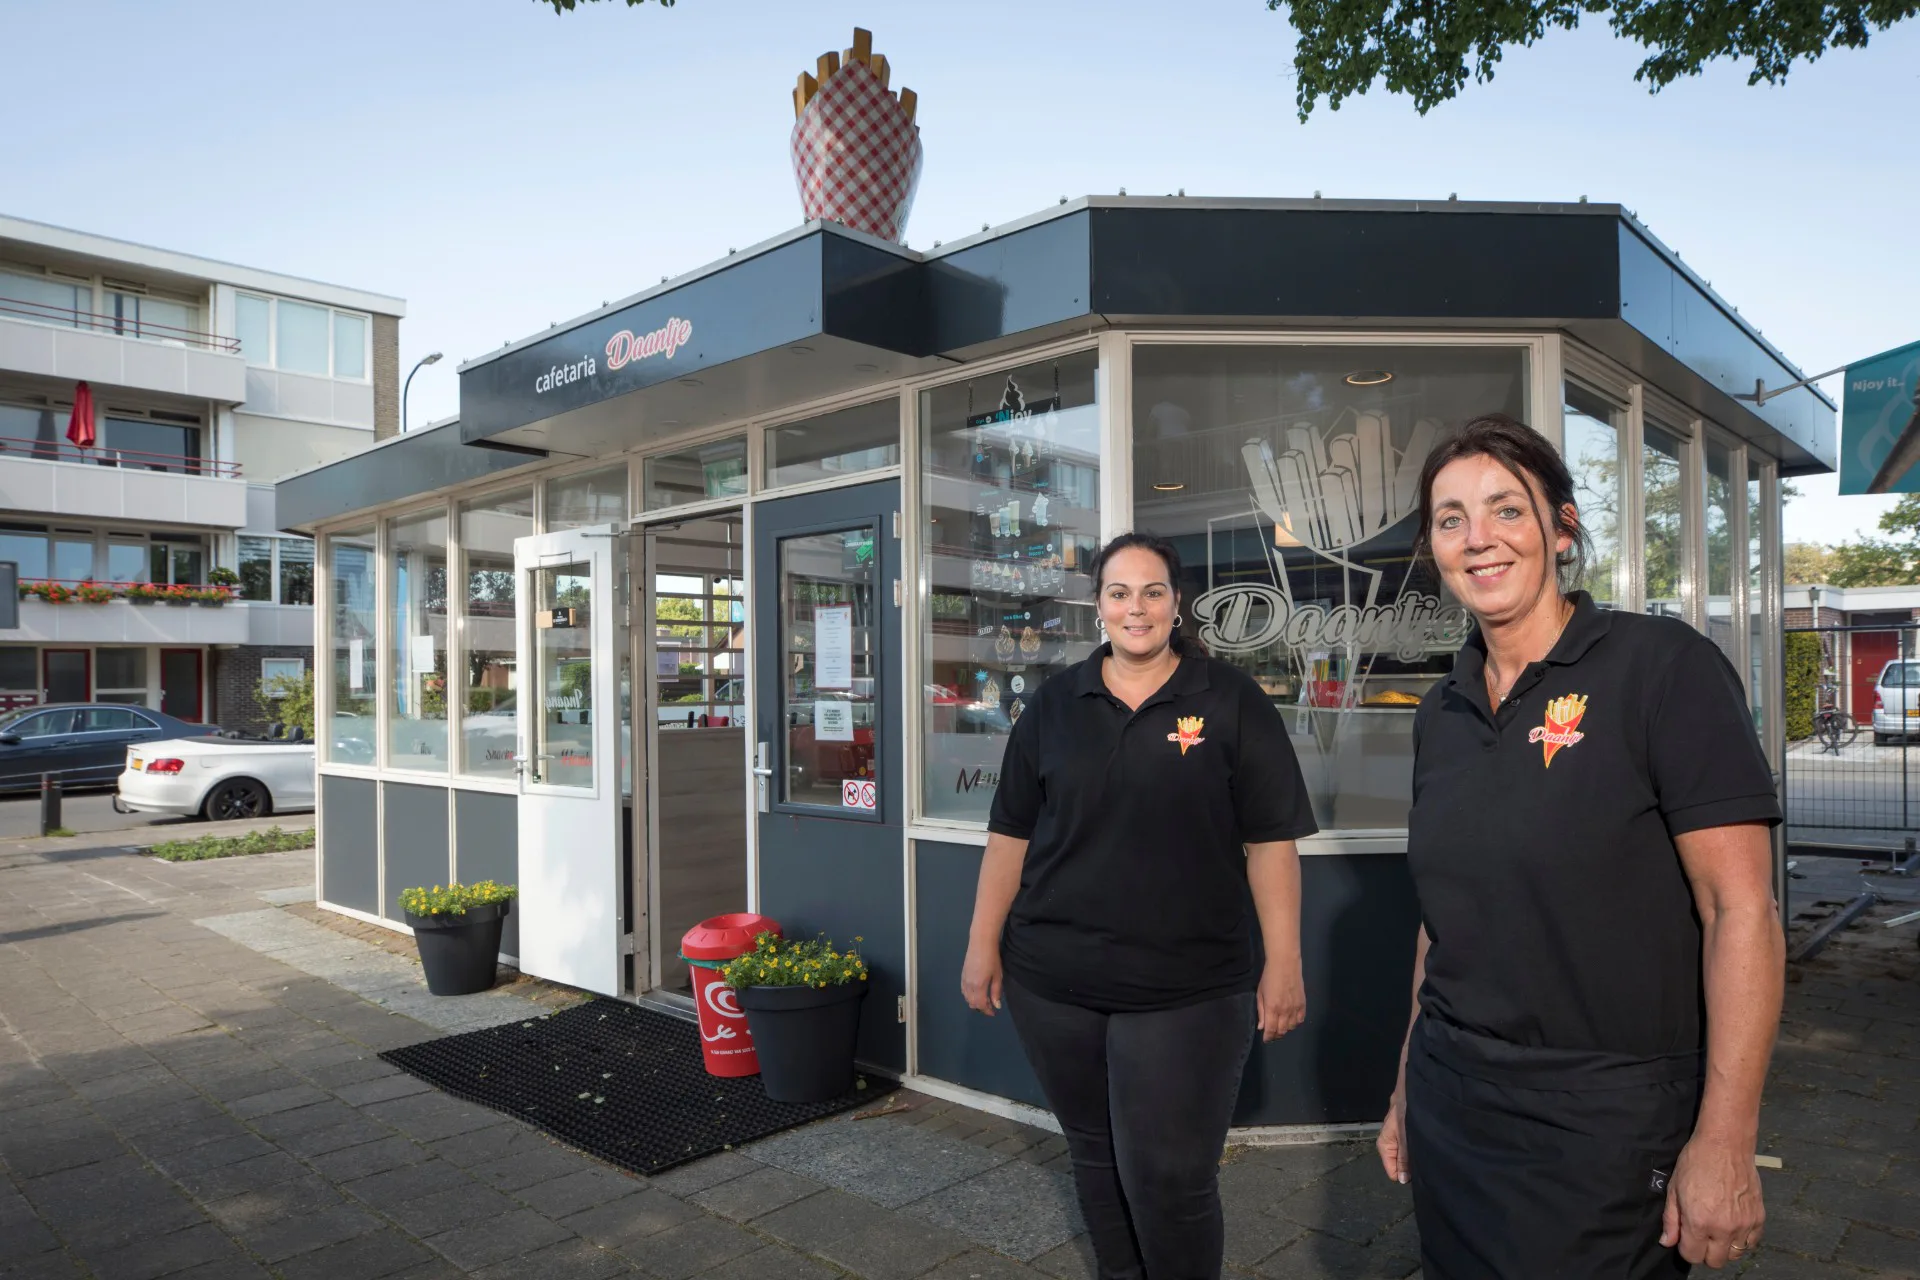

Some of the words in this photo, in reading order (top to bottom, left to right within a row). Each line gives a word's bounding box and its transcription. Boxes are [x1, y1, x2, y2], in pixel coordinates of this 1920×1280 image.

[535, 354, 597, 393] cafetaria
[605, 316, 692, 370] Daantje
[1852, 379, 1885, 392] Njoy
[1192, 582, 1475, 663] Daantje
